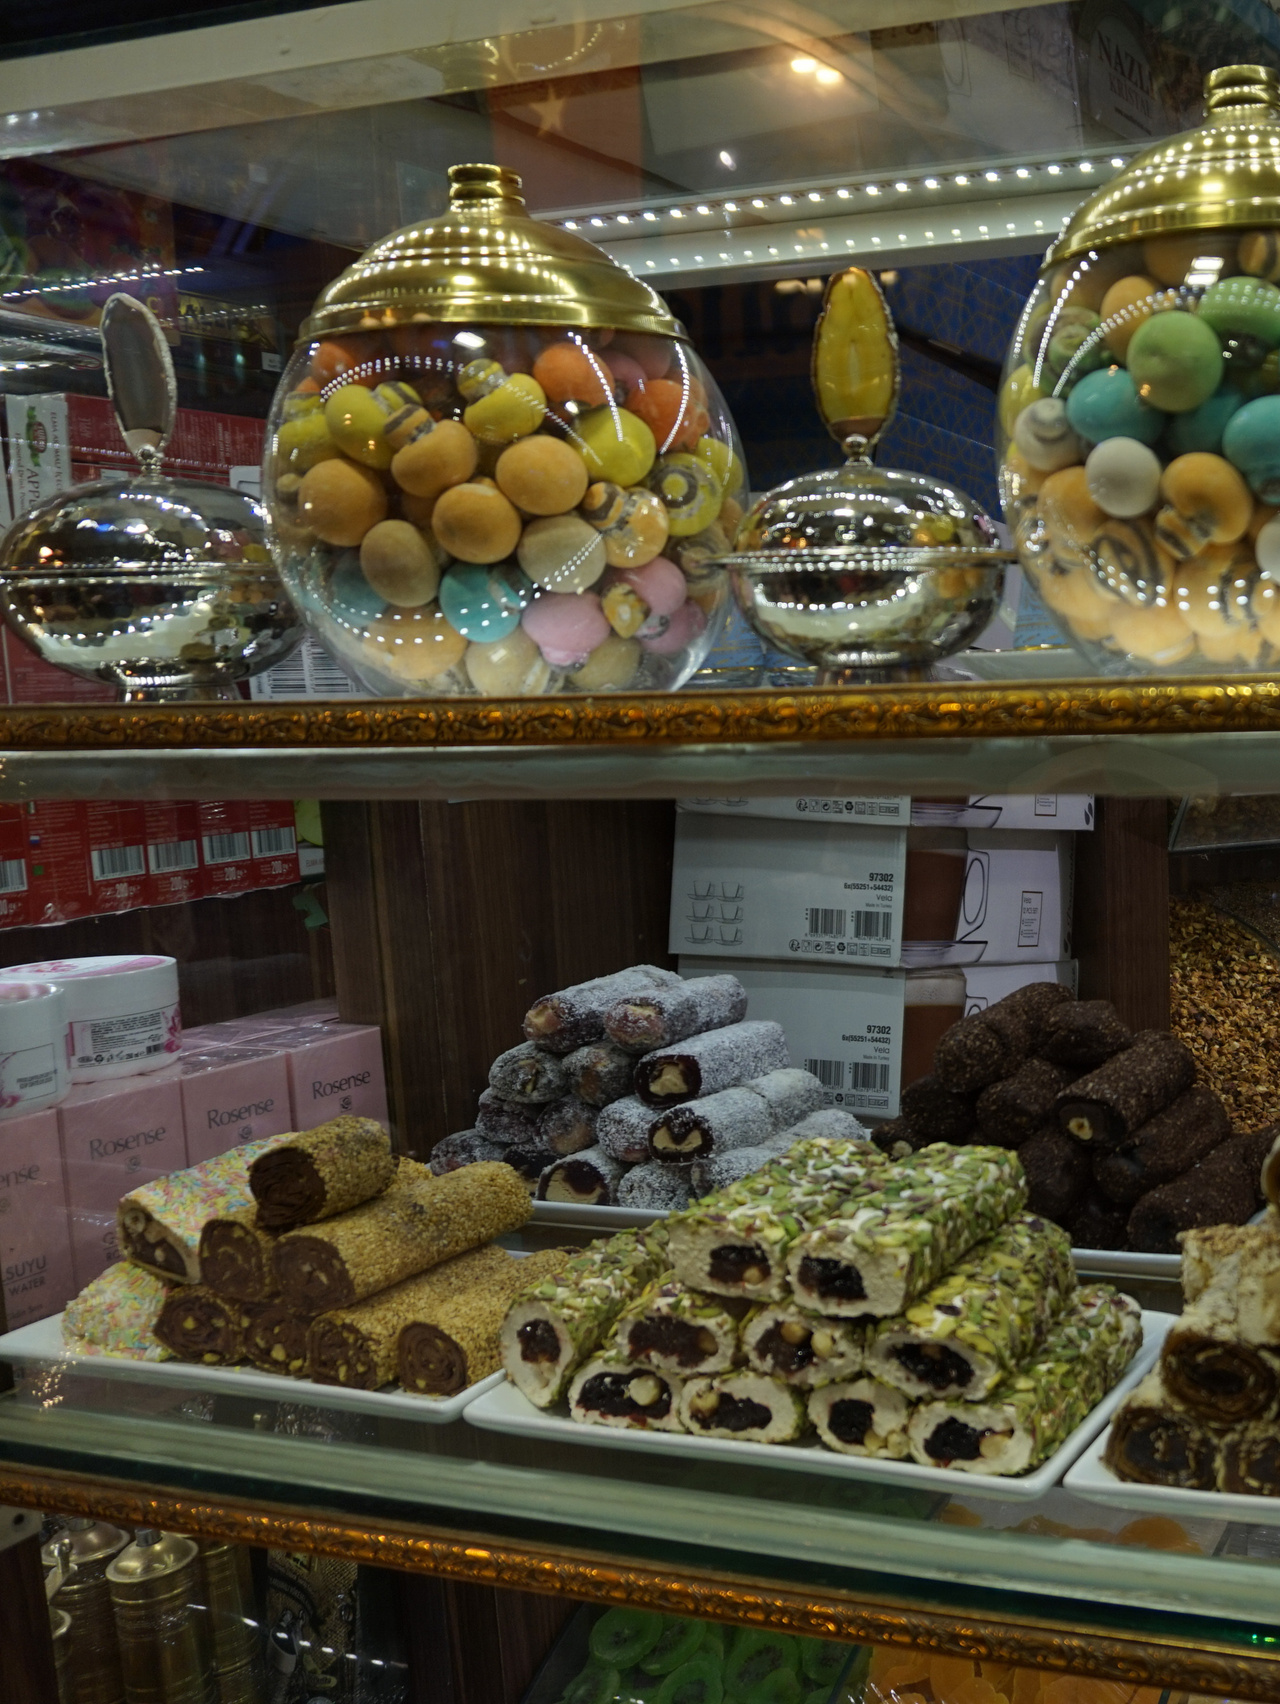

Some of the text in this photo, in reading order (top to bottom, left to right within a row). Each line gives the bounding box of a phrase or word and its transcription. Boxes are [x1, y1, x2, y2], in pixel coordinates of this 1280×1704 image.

[27, 468, 40, 508] APPL
[869, 872, 894, 883] 97302
[876, 893, 893, 902] Vela
[866, 1024, 892, 1035] 97302
[873, 1046, 890, 1054] Vela
[312, 1068, 371, 1100] Rosense
[207, 1096, 275, 1130] Rosense
[89, 1123, 166, 1160] Rosense
[8, 1276, 46, 1296] WATER
